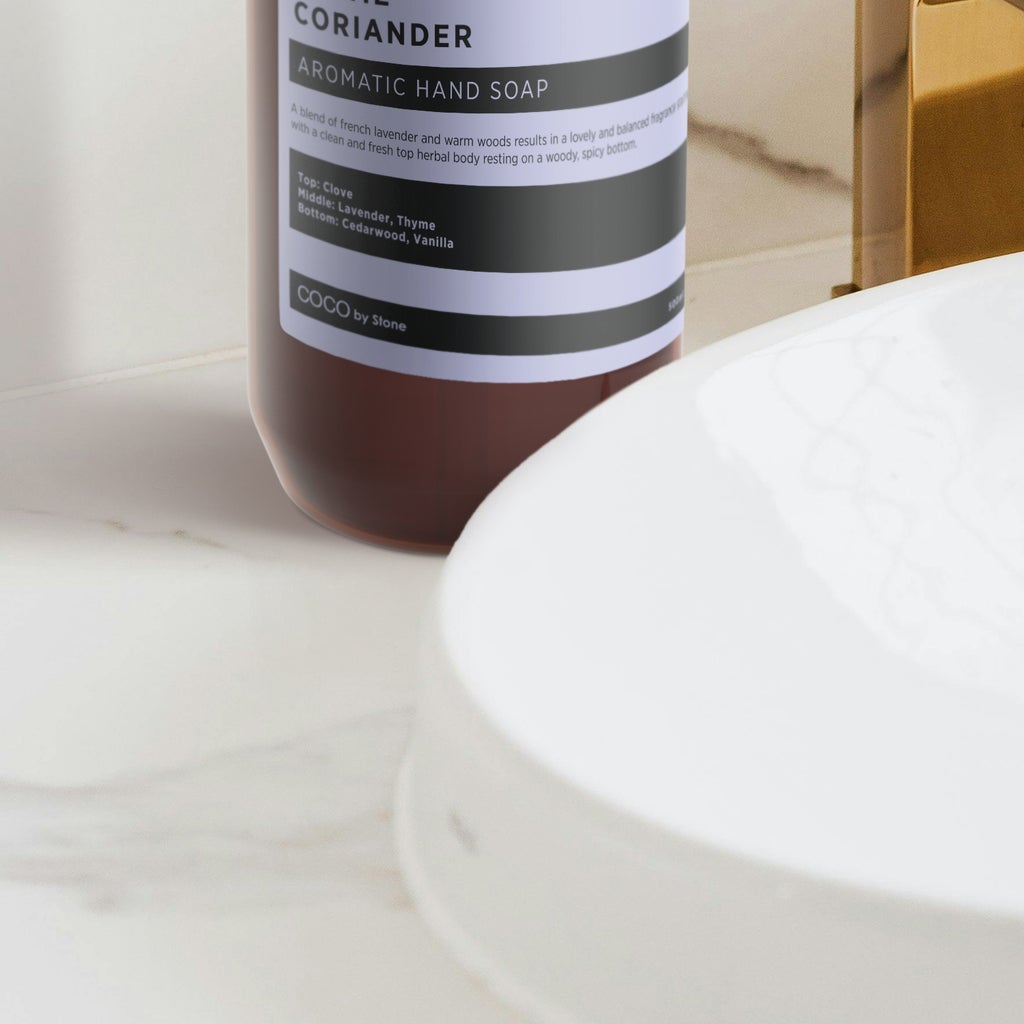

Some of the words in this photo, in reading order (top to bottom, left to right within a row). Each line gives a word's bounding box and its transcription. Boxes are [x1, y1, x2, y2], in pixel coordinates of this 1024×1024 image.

[294, 0, 473, 49] CORIANDER
[298, 56, 406, 96] AROMATIC
[416, 79, 480, 100] HAND
[490, 78, 549, 100] SOAP
[291, 102, 298, 114] A
[300, 106, 326, 124] blend
[327, 117, 338, 127] of
[340, 118, 371, 136] french
[374, 126, 418, 143] lavender
[421, 134, 441, 145] and
[444, 136, 474, 147] warm
[477, 136, 512, 147] woods
[514, 134, 547, 146] results
[550, 133, 559, 145] in
[561, 134, 567, 144] a
[570, 129, 597, 143] lovely
[598, 125, 615, 139] and
[616, 115, 650, 136] balanced
[291, 119, 310, 135] with
[312, 128, 318, 137] a
[320, 130, 345, 146] clean
[346, 138, 366, 151] and
[368, 141, 394, 156] fresh
[396, 146, 414, 160] top
[417, 148, 450, 163] herbal
[453, 152, 480, 166] body
[483, 152, 518, 166] resting
[521, 154, 534, 164] on
[536, 154, 543, 164] a
[581, 146, 605, 160] spicy
[298, 171, 321, 189] Top:
[323, 181, 354, 200] Clove
[297, 187, 336, 210] Middle:
[338, 201, 394, 226] Lavender,
[397, 215, 436, 232] Thyme
[297, 202, 340, 227] Bottom:
[342, 218, 411, 245] Cedarwood,
[413, 233, 454, 249] Vanilla
[297, 284, 351, 318] COCO
[353, 309, 369, 325] by
[372, 314, 408, 332] Stone
